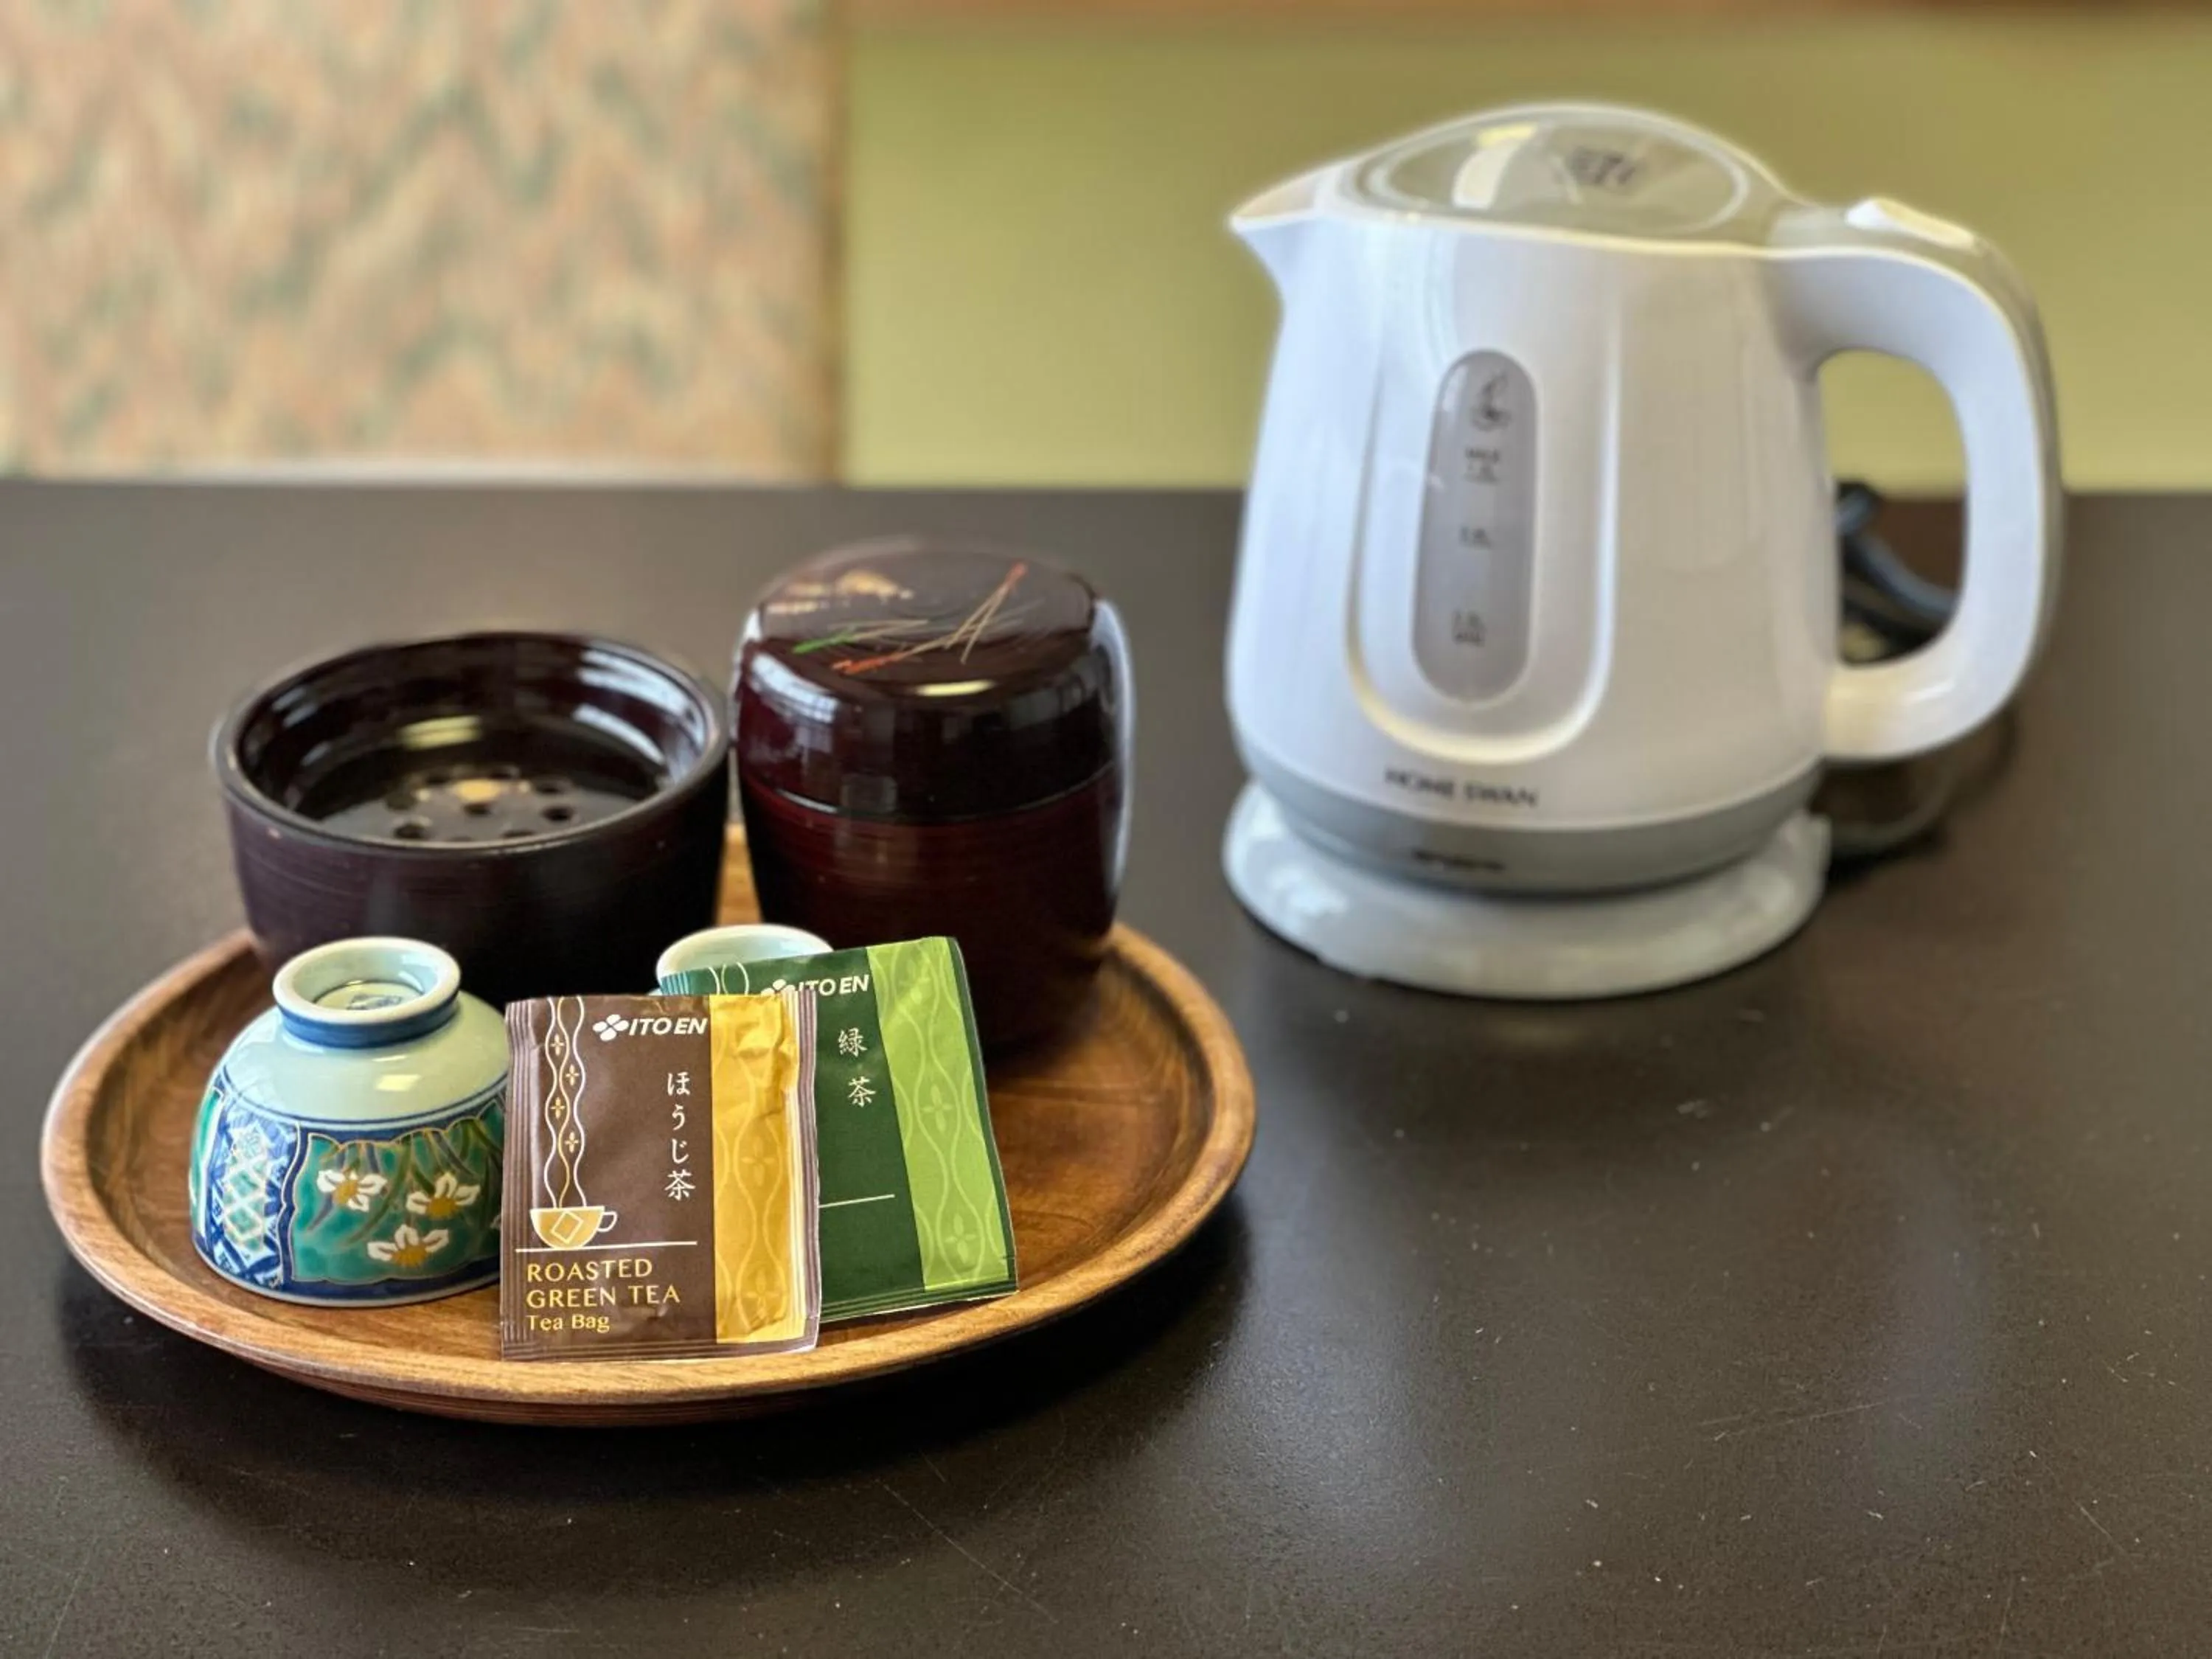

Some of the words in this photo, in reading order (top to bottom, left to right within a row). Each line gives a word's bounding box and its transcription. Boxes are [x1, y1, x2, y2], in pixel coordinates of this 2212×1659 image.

[838, 1027, 876, 1107] 緑茶
[664, 1071, 696, 1200] ほうじ茶
[526, 1259, 653, 1283] ROASTED
[526, 1287, 616, 1308] GREEN
[628, 1284, 681, 1304] TEA
[526, 1315, 563, 1331] Tea
[571, 1313, 611, 1332] Bag
